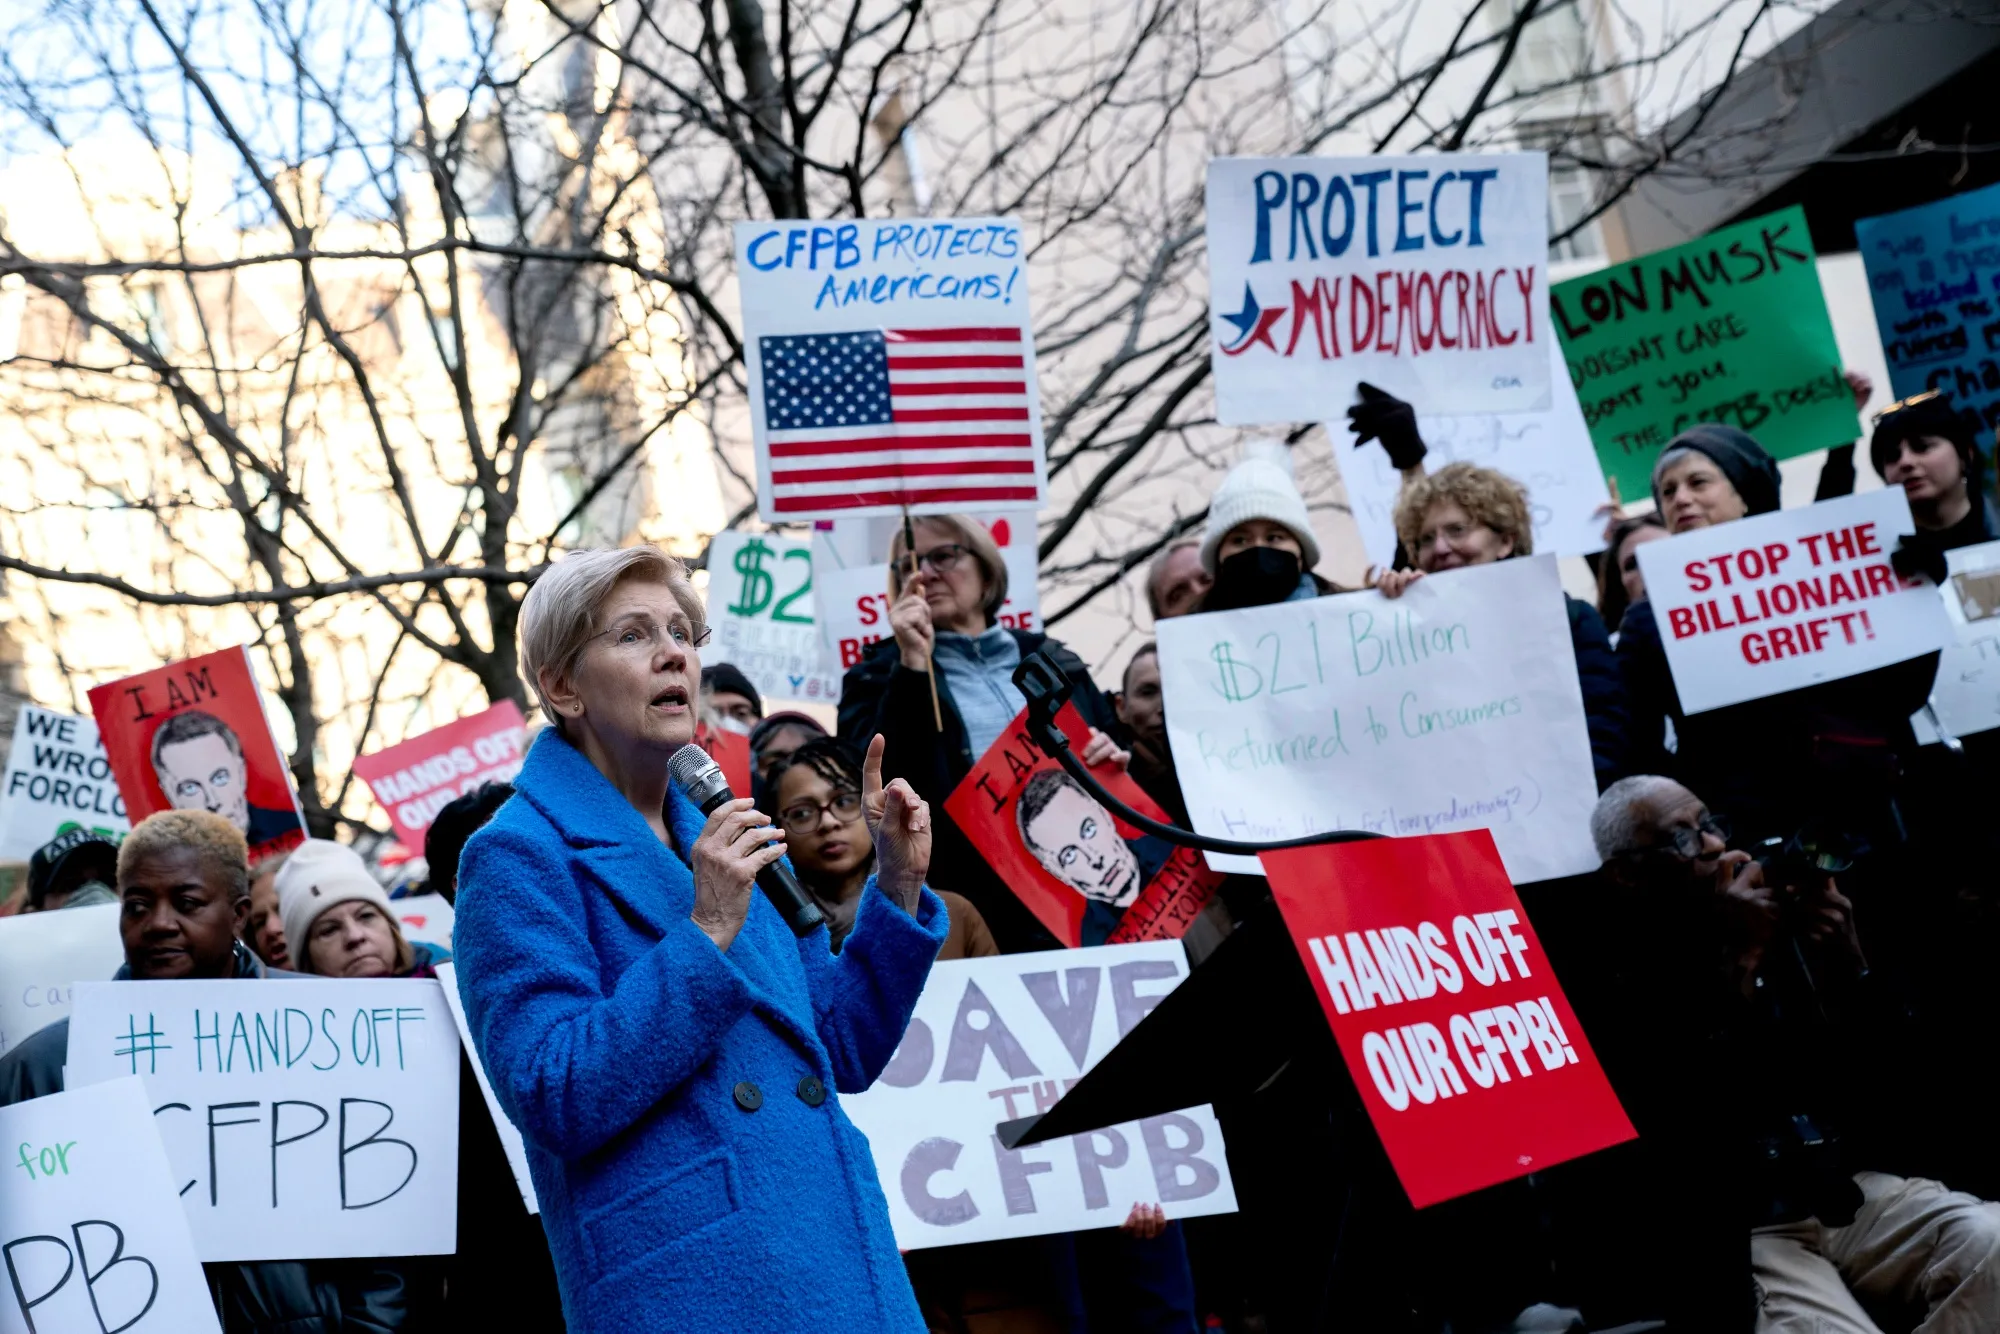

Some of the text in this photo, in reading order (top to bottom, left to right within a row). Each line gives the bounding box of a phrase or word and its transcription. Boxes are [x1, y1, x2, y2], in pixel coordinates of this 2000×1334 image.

[747, 224, 1020, 272] CFPB PROTECTS
[1249, 169, 1498, 264] PROTECT
[1660, 221, 1808, 314] MUSK
[1284, 265, 1536, 360] MY DEMOCRACY
[1676, 312, 1748, 355] CARE
[1684, 522, 1882, 593] STOP THE
[1210, 608, 1470, 704] $21 Billion
[1740, 610, 1876, 666] GRIFT!
[126, 665, 219, 722] I AM
[27, 711, 77, 744] WE
[1197, 690, 1523, 773] Returned to Consumers
[33, 742, 118, 781] WRO
[371, 746, 477, 807] HANDS
[975, 771, 1008, 815] I
[1308, 908, 1532, 1015] HANDS OFF
[1362, 996, 1580, 1112] OUR CFPB!
[16, 1140, 78, 1181] for
[900, 1112, 1221, 1228] CFPB
